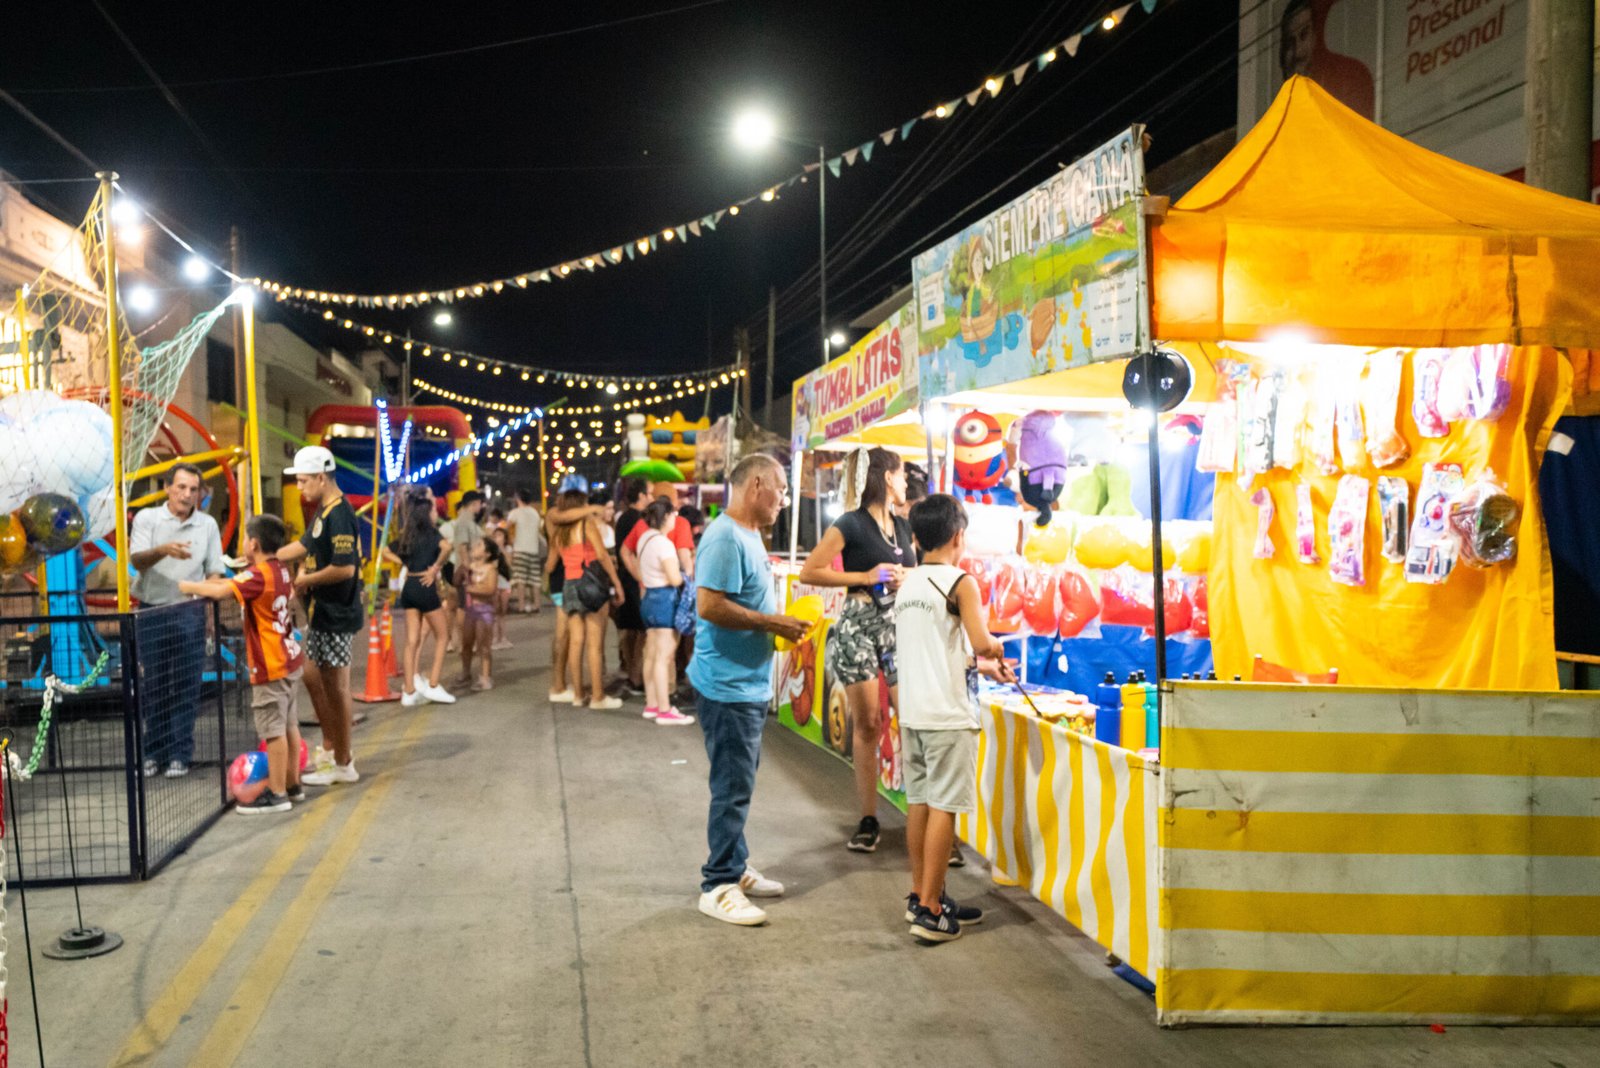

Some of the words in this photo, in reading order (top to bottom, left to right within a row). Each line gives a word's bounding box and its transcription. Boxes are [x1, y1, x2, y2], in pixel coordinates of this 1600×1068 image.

[1406, 3, 1505, 83] Personal
[983, 181, 1068, 270] SIEMPRE
[1071, 140, 1136, 228] GANA
[814, 366, 853, 416] TUMBA
[856, 326, 902, 399] LATAS
